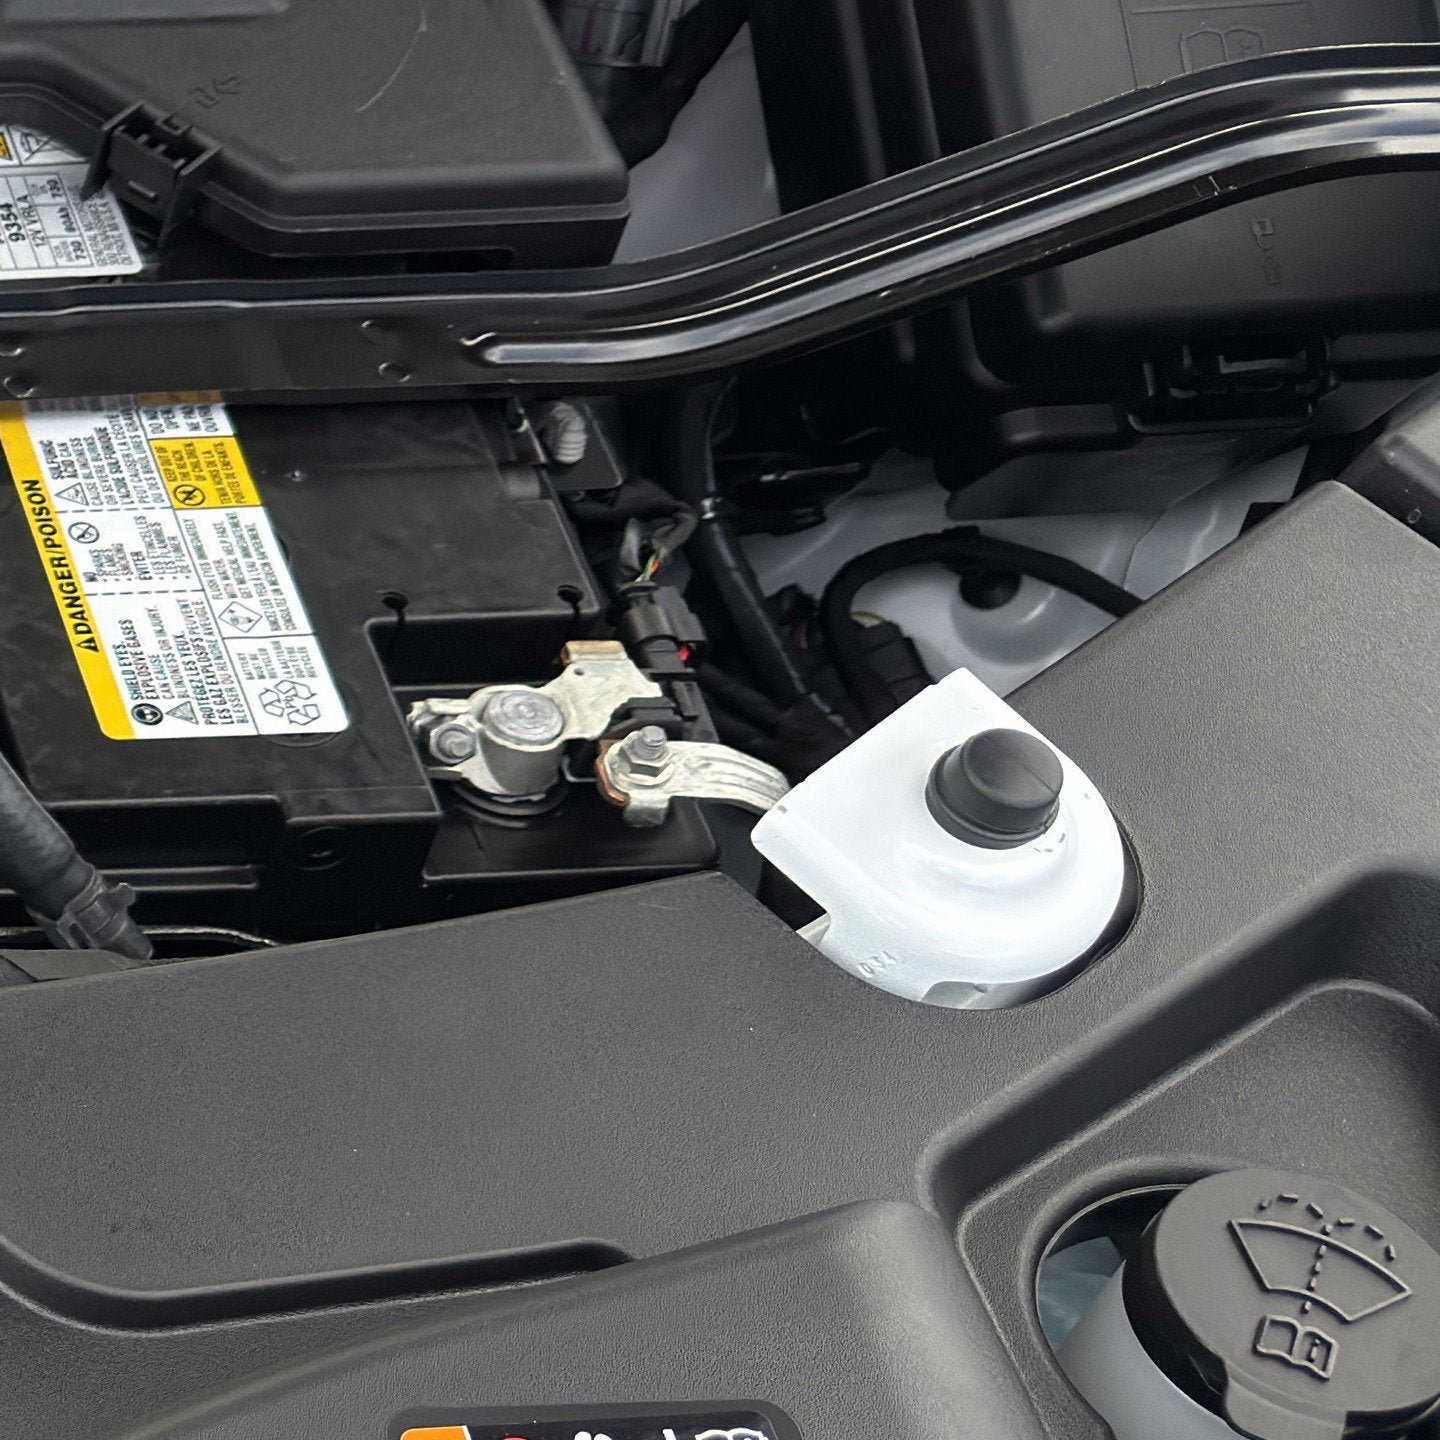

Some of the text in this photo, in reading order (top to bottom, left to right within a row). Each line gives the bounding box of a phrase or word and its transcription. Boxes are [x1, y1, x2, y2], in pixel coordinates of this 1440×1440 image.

[20, 478, 94, 635] DANGER/POISON
[117, 618, 160, 700] EXPLOSIVE GASES
[146, 653, 175, 699] CAN CAUSE
[161, 652, 190, 698] BLINDNESS
[174, 598, 236, 725] LES GAZ EXPLOSIFS PEUVENT
[180, 659, 201, 677] LES
[204, 638, 229, 671] RENDRE
[120, 668, 145, 700] SHIELD
[222, 685, 250, 724] BLESSER
